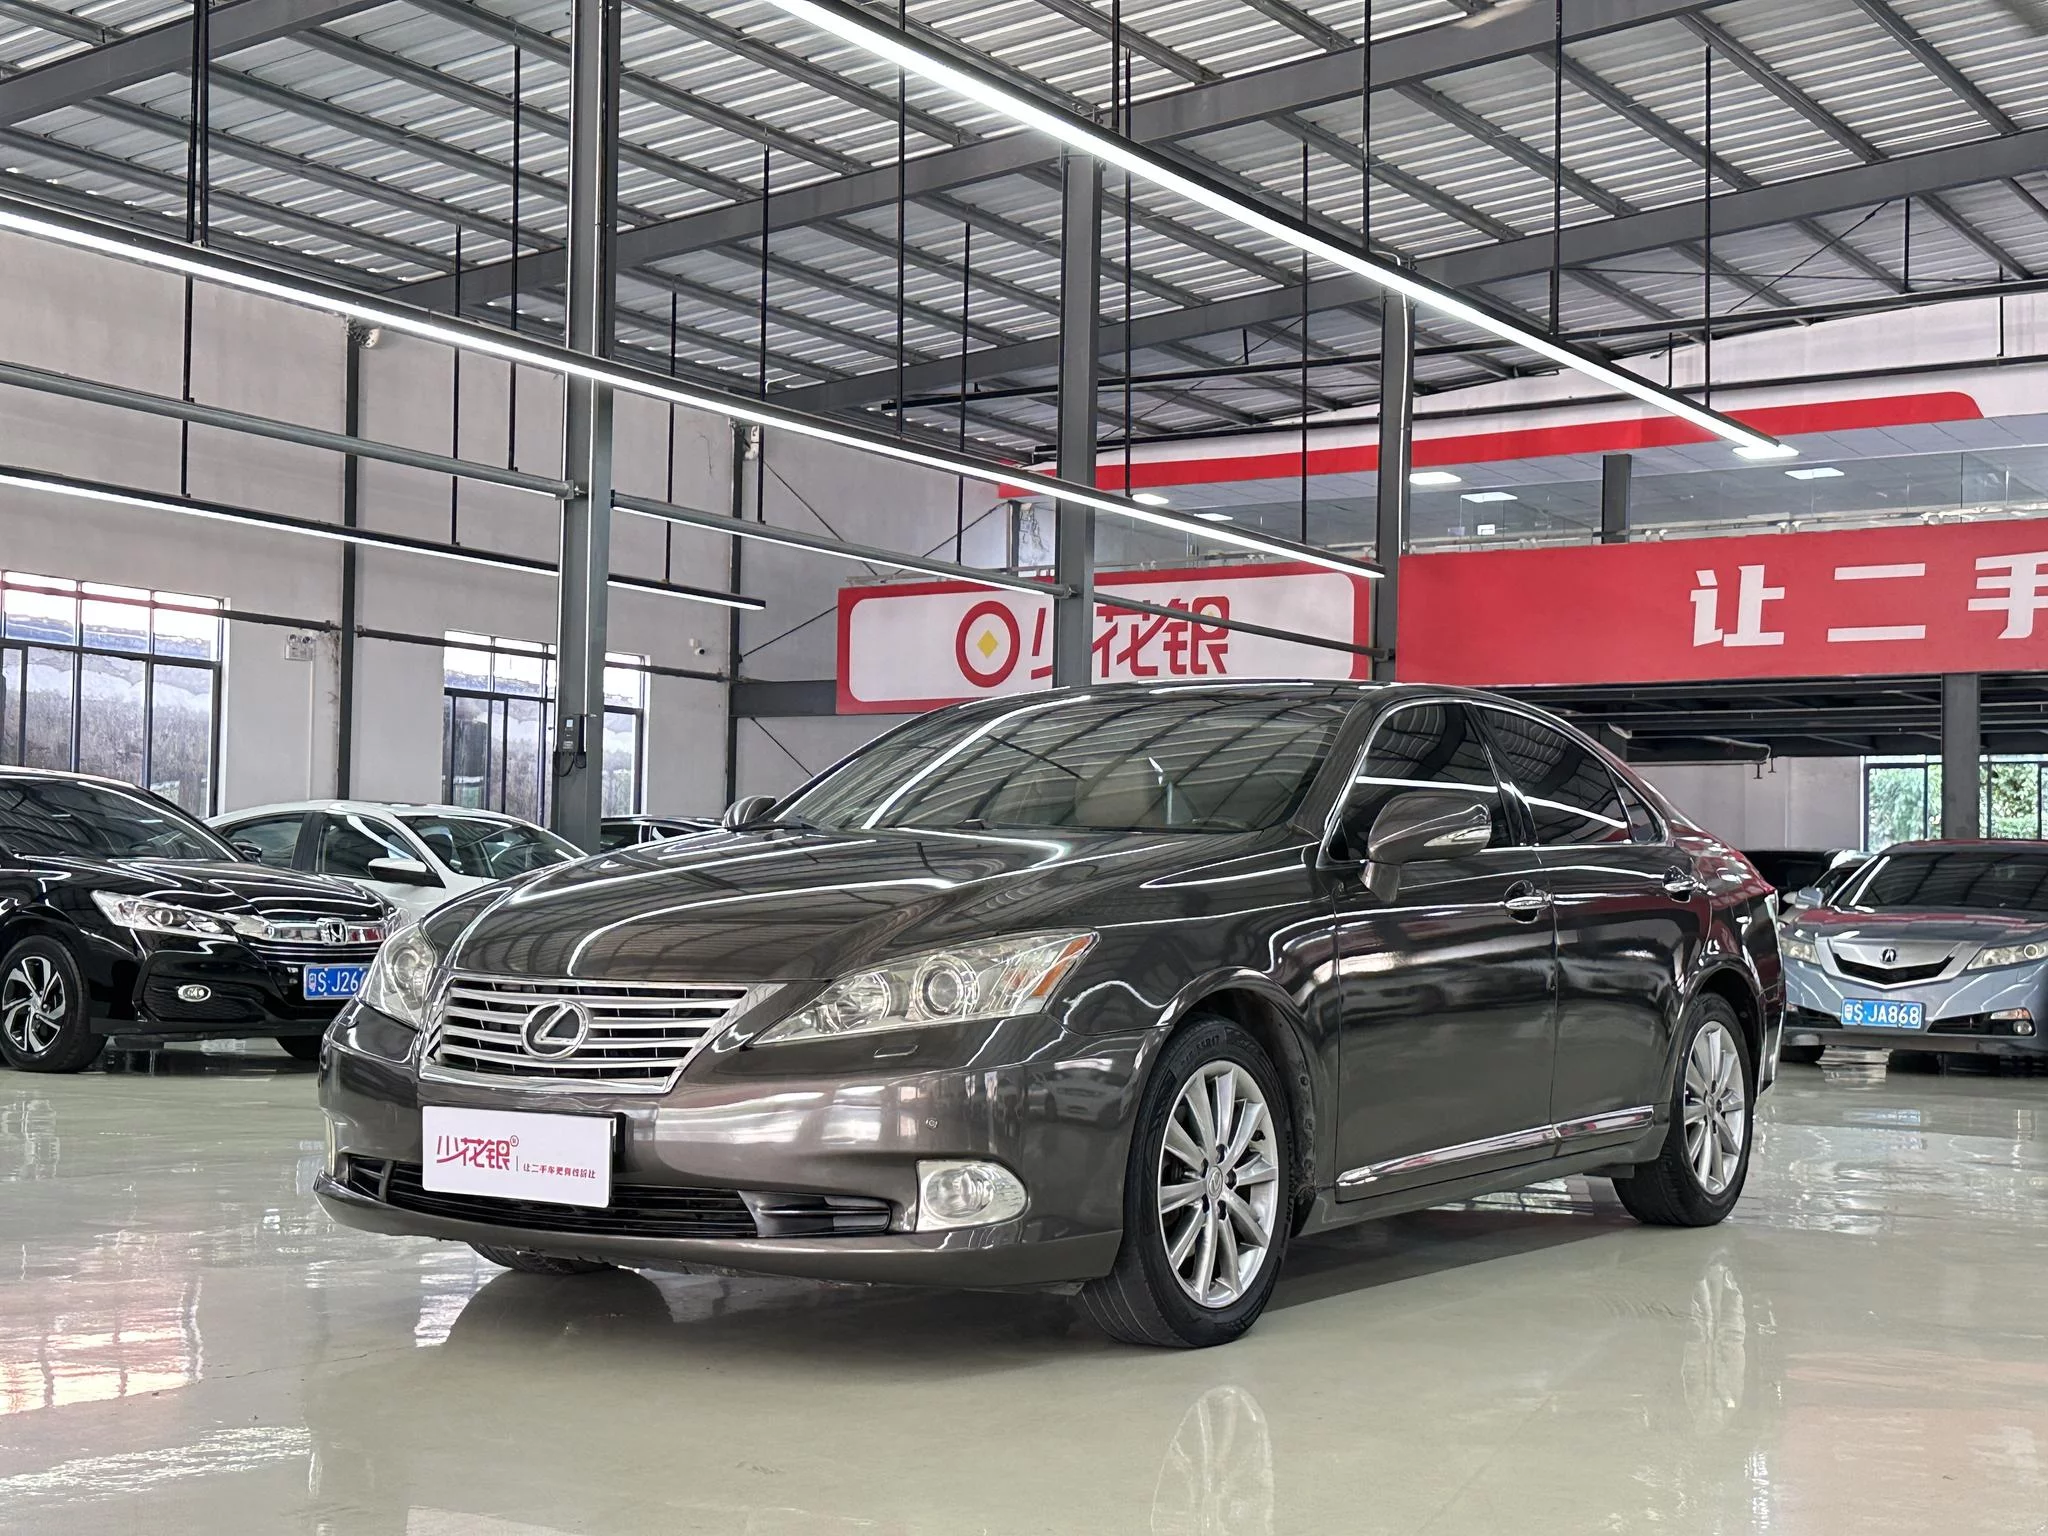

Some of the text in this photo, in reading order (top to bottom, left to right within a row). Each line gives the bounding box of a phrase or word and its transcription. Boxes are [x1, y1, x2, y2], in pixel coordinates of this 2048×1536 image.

[1690, 551, 2048, 647] 让二手
[309, 970, 367, 993] 粤S·J26
[436, 1135, 511, 1171] 小花银
